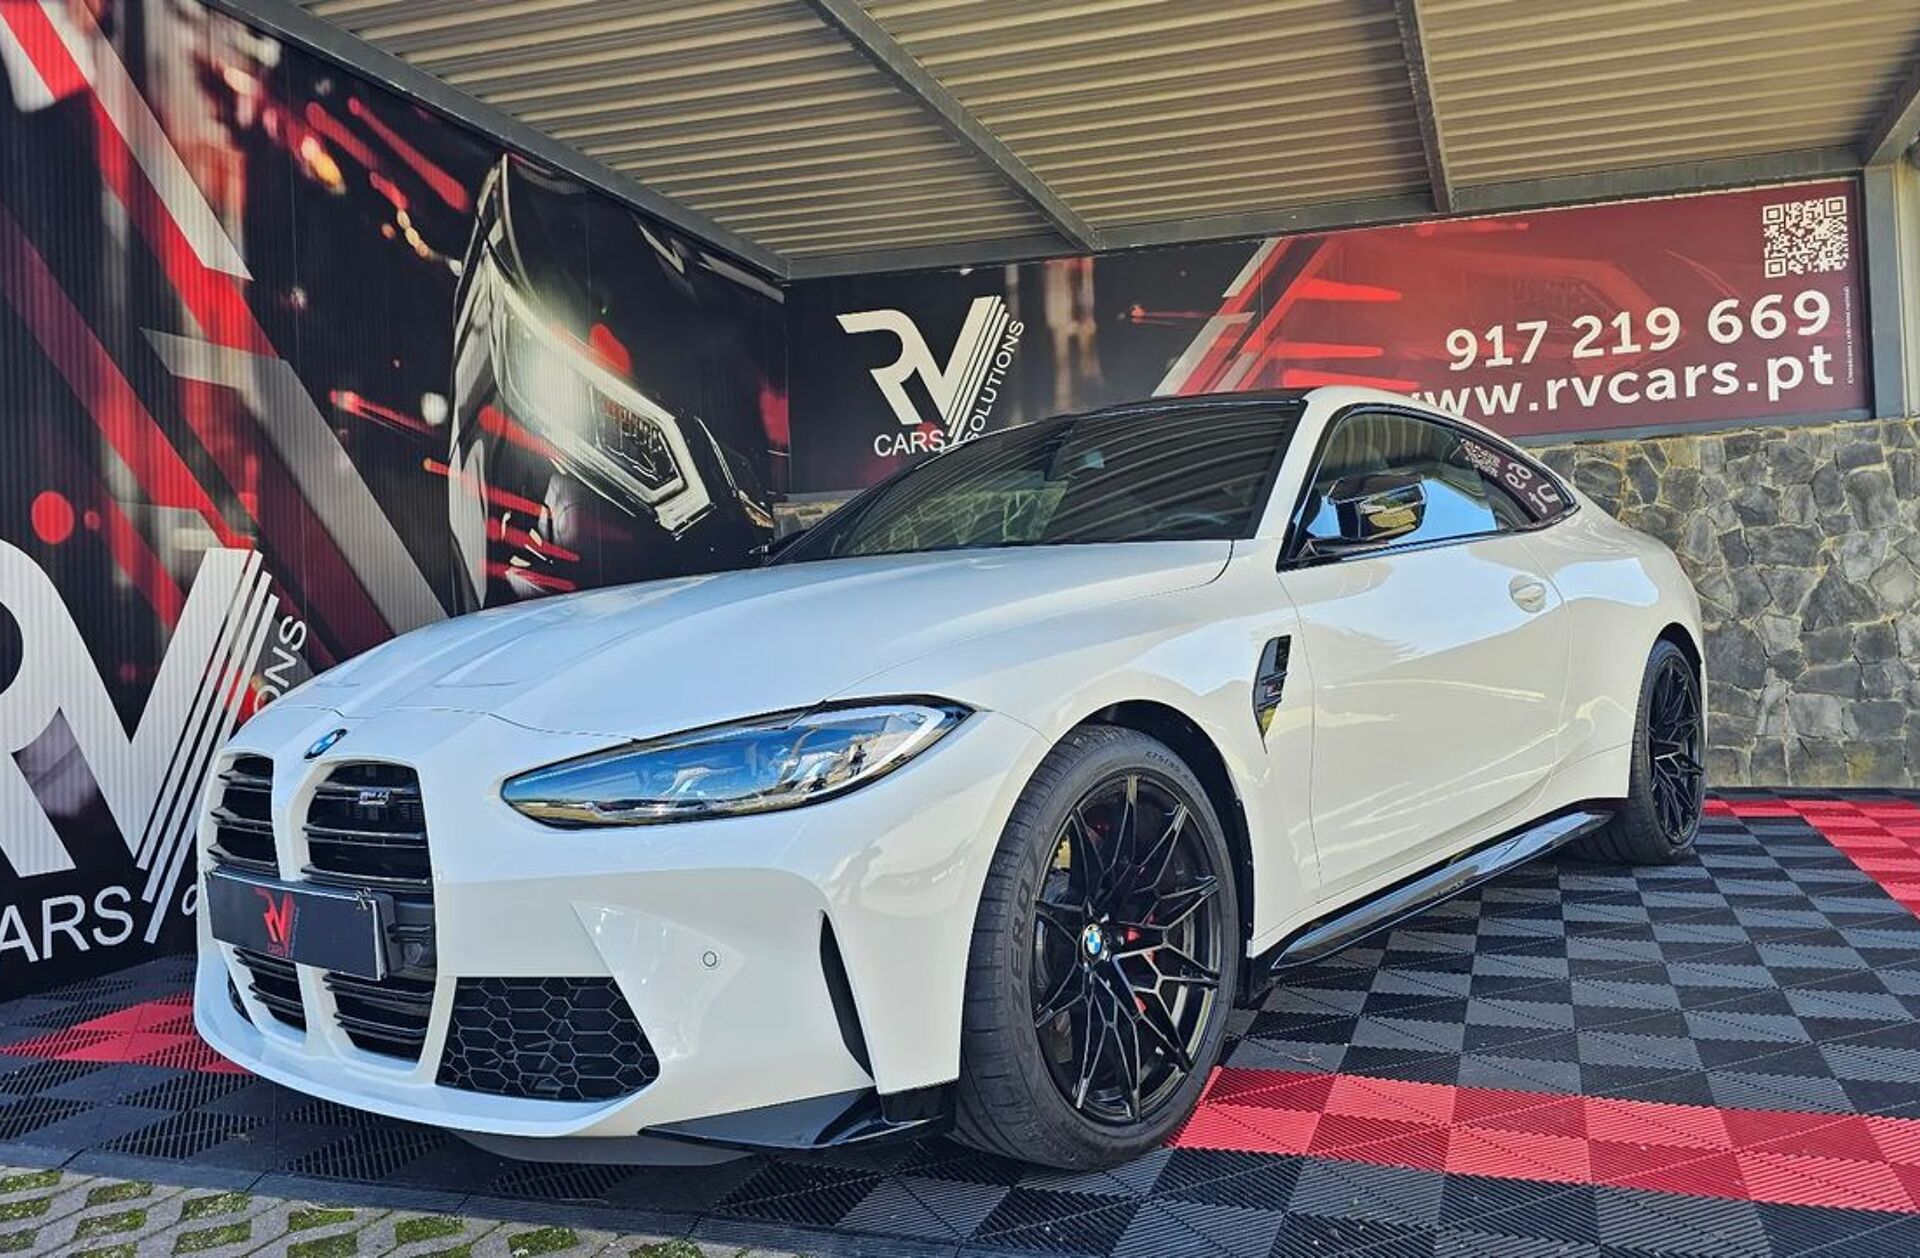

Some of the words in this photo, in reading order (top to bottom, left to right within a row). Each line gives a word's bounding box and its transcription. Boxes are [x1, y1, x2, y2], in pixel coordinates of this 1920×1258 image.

[836, 295, 1006, 438] RV
[1446, 321, 1547, 371] 917
[1572, 307, 1681, 358] 219
[1707, 290, 1830, 344] 669
[965, 320, 1024, 441] SOLUTIONS
[1411, 344, 1833, 416] ww.rvcars.pt
[874, 430, 945, 456] CARS
[0, 886, 134, 962] ARS
